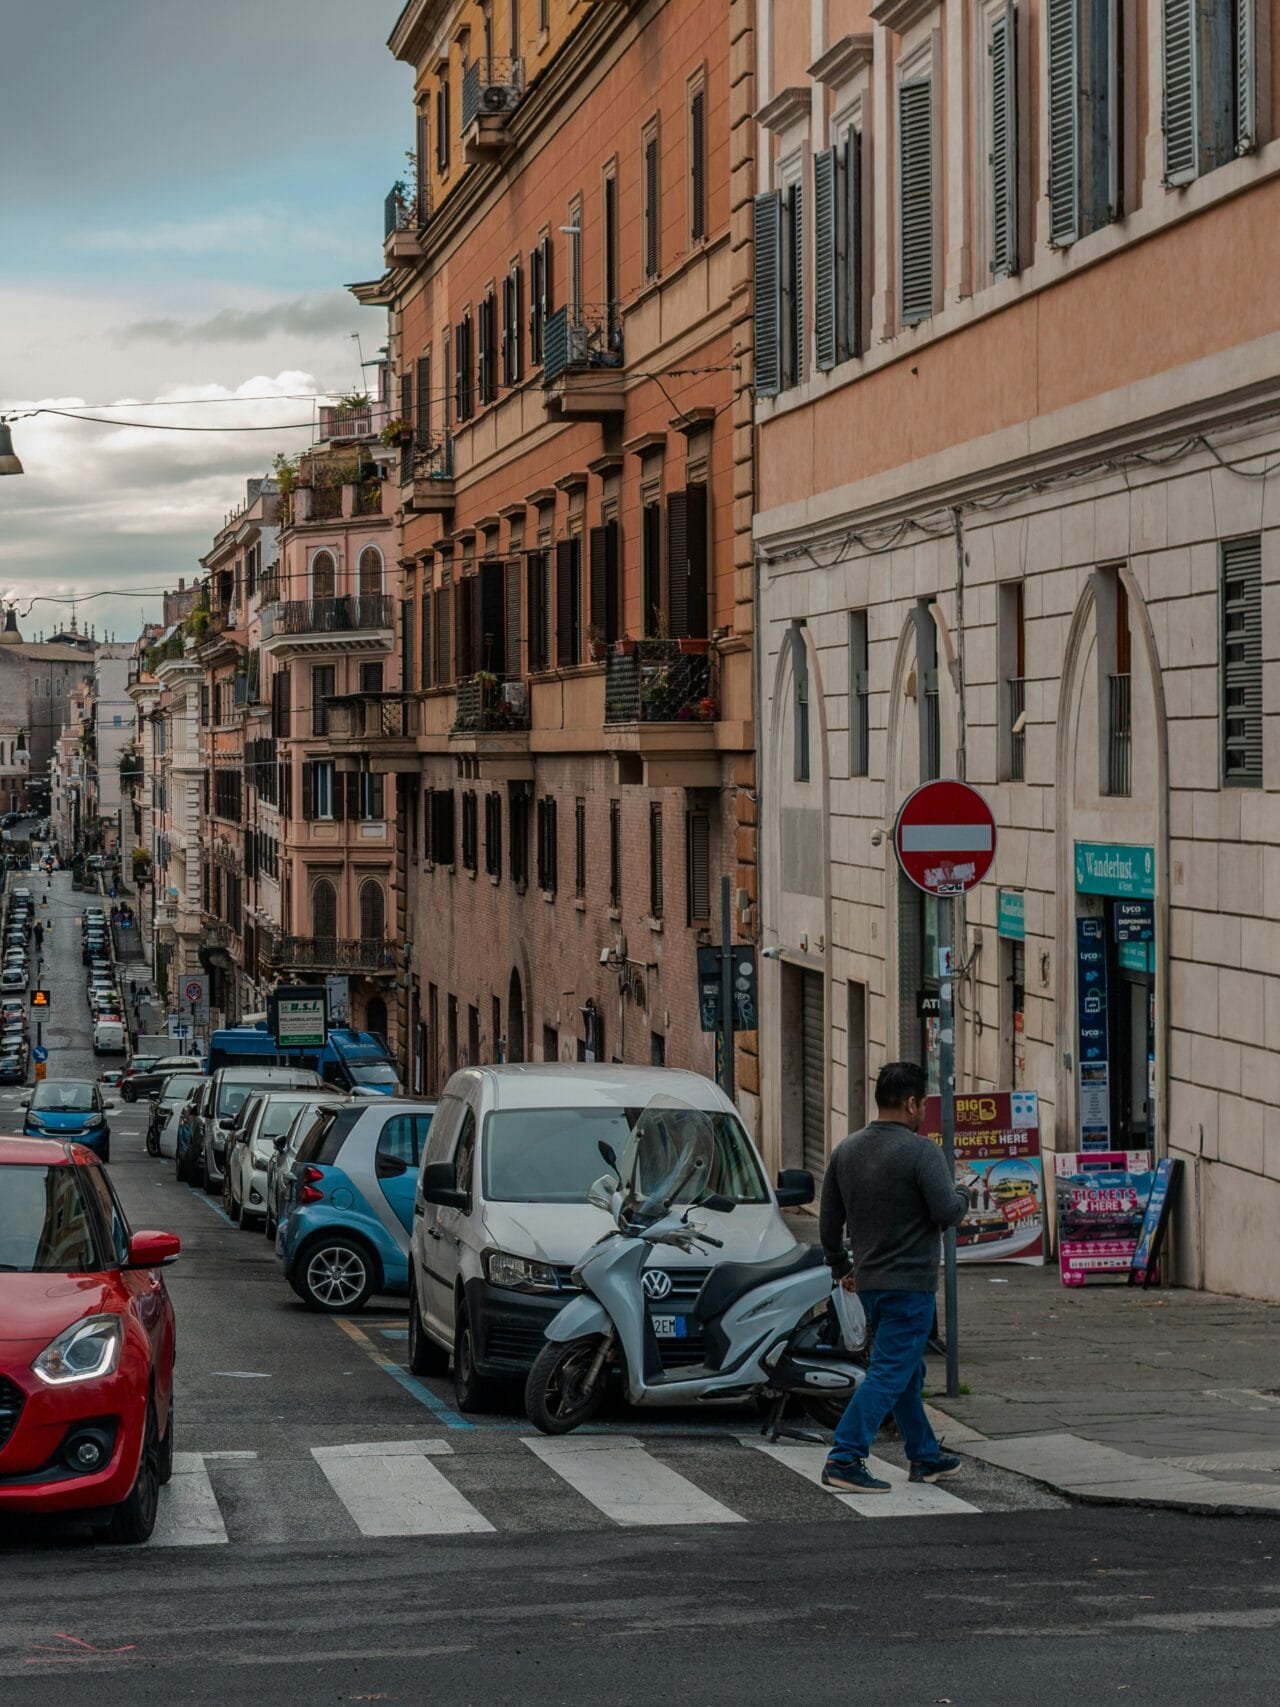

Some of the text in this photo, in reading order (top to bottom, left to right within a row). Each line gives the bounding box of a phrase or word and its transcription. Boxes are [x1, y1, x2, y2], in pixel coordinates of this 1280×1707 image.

[1085, 851, 1133, 879] Wanderlust
[1121, 904, 1141, 914] Lyca
[1080, 951, 1098, 961] Lyca
[921, 998, 940, 1010] AT
[1081, 1028, 1099, 1037] Lyca
[956, 1099, 979, 1111] BIG
[956, 1111, 979, 1122] BUS
[953, 1135, 997, 1146] TICKETS
[999, 1133, 1029, 1144] HERE
[1072, 1188, 1137, 1200] TICKETS
[1090, 1201, 1120, 1211] HERE
